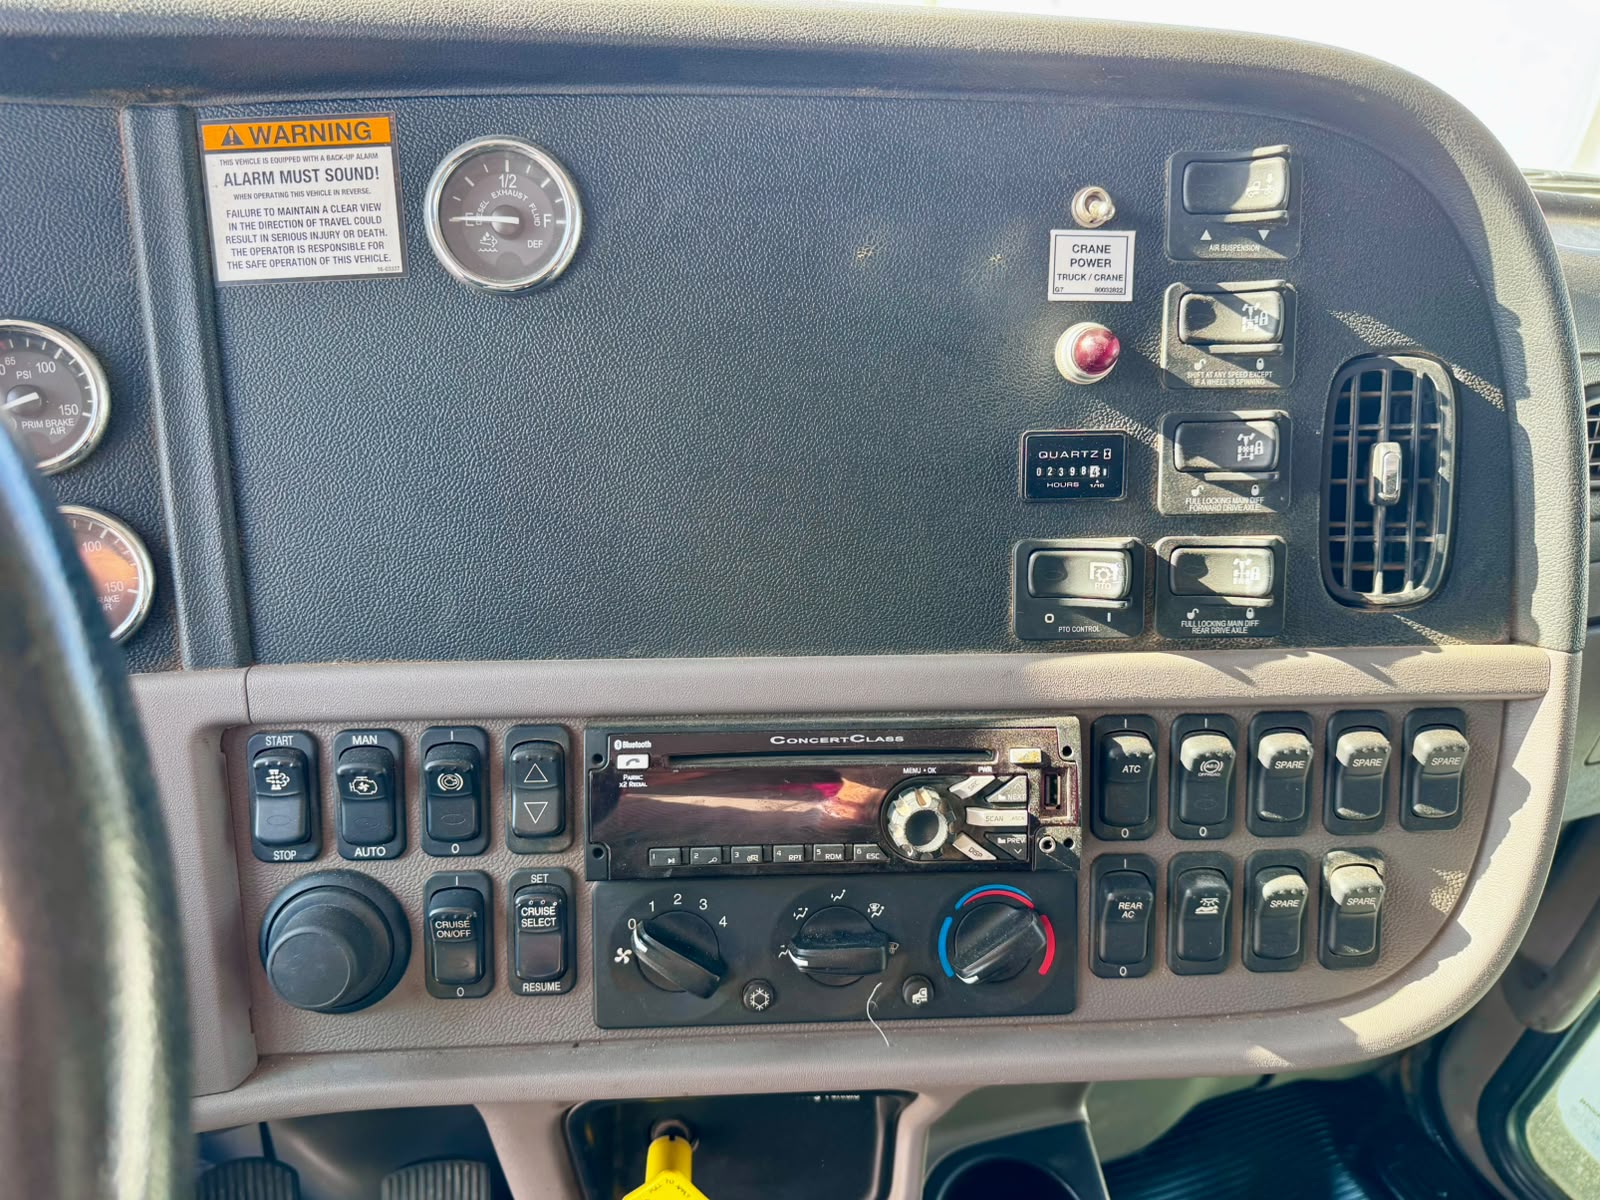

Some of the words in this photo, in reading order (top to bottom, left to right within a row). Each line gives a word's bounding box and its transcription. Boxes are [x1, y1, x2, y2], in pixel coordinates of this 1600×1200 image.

[249, 121, 372, 145] WARNING
[224, 171, 274, 186] ALARM
[280, 169, 319, 184] MUST
[325, 166, 379, 182] SOUND!
[499, 174, 517, 189] 1/2
[227, 208, 261, 218] FAILURE
[264, 208, 274, 216] TO
[278, 206, 320, 215] MAINTAIN
[330, 204, 358, 213] CLEAR
[360, 203, 381, 212] VIEW
[491, 190, 528, 201] EXHAUST
[529, 203, 540, 226] FLUID
[229, 223, 237, 231] IN
[240, 222, 256, 230] THE
[259, 220, 303, 229] DIRECTION
[307, 219, 317, 227] OF
[319, 218, 352, 227] TRAVEL
[354, 216, 381, 225] COULD
[544, 214, 552, 228] F
[226, 235, 257, 244] RESULT
[260, 234, 269, 242] IN
[272, 232, 307, 241] SERIOUS
[310, 230, 340, 239] INJURY
[343, 230, 354, 238] OR
[357, 229, 387, 238] DEATH.
[232, 248, 247, 256] THE
[250, 245, 294, 255] OPERATOR
[297, 245, 305, 253] IS
[308, 243, 365, 253] RESPONSIBLE
[368, 242, 384, 250] FOR
[528, 240, 543, 248] DEF
[1072, 245, 1111, 254] CRANE
[228, 262, 243, 270] THE
[246, 261, 267, 269] SAFE
[270, 258, 317, 268] OPERATION
[333, 256, 352, 264] THIS
[354, 254, 391, 263] VEHICLE.
[1070, 258, 1112, 268] POWER
[1057, 273, 1086, 281] TRUCK
[1094, 274, 1123, 282] CRANE
[5, 357, 15, 365] 65
[36, 361, 56, 373] 100
[16, 371, 31, 379] PSI
[59, 404, 79, 415] 150
[22, 421, 43, 429] PRIM
[45, 418, 74, 428] BRAKE
[50, 427, 66, 435] AIR
[1039, 451, 1098, 459] QUARTZ
[83, 541, 102, 552] 100
[105, 581, 124, 592] 150
[266, 736, 293, 745] START
[352, 736, 377, 745] MAN
[1274, 761, 1305, 769] SPARE
[1353, 758, 1382, 767] SPARE
[1431, 757, 1461, 766] SPARE
[1122, 765, 1141, 773] ATC
[273, 851, 296, 860] STOP
[355, 847, 386, 856] AUTO
[968, 847, 983, 857] DISP
[530, 875, 548, 883] SET
[673, 894, 682, 905] 2
[700, 899, 708, 910] 3
[1270, 899, 1300, 908] SPARE
[1347, 897, 1375, 906] SPARE
[649, 901, 655, 912] 1
[1118, 902, 1143, 910] REAR
[521, 907, 556, 916] CRUISE
[521, 918, 557, 927] SELECT
[627, 919, 637, 929] 0
[718, 916, 727, 927] 4
[437, 930, 471, 938] ON/OFF
[523, 982, 560, 992] RESUME
